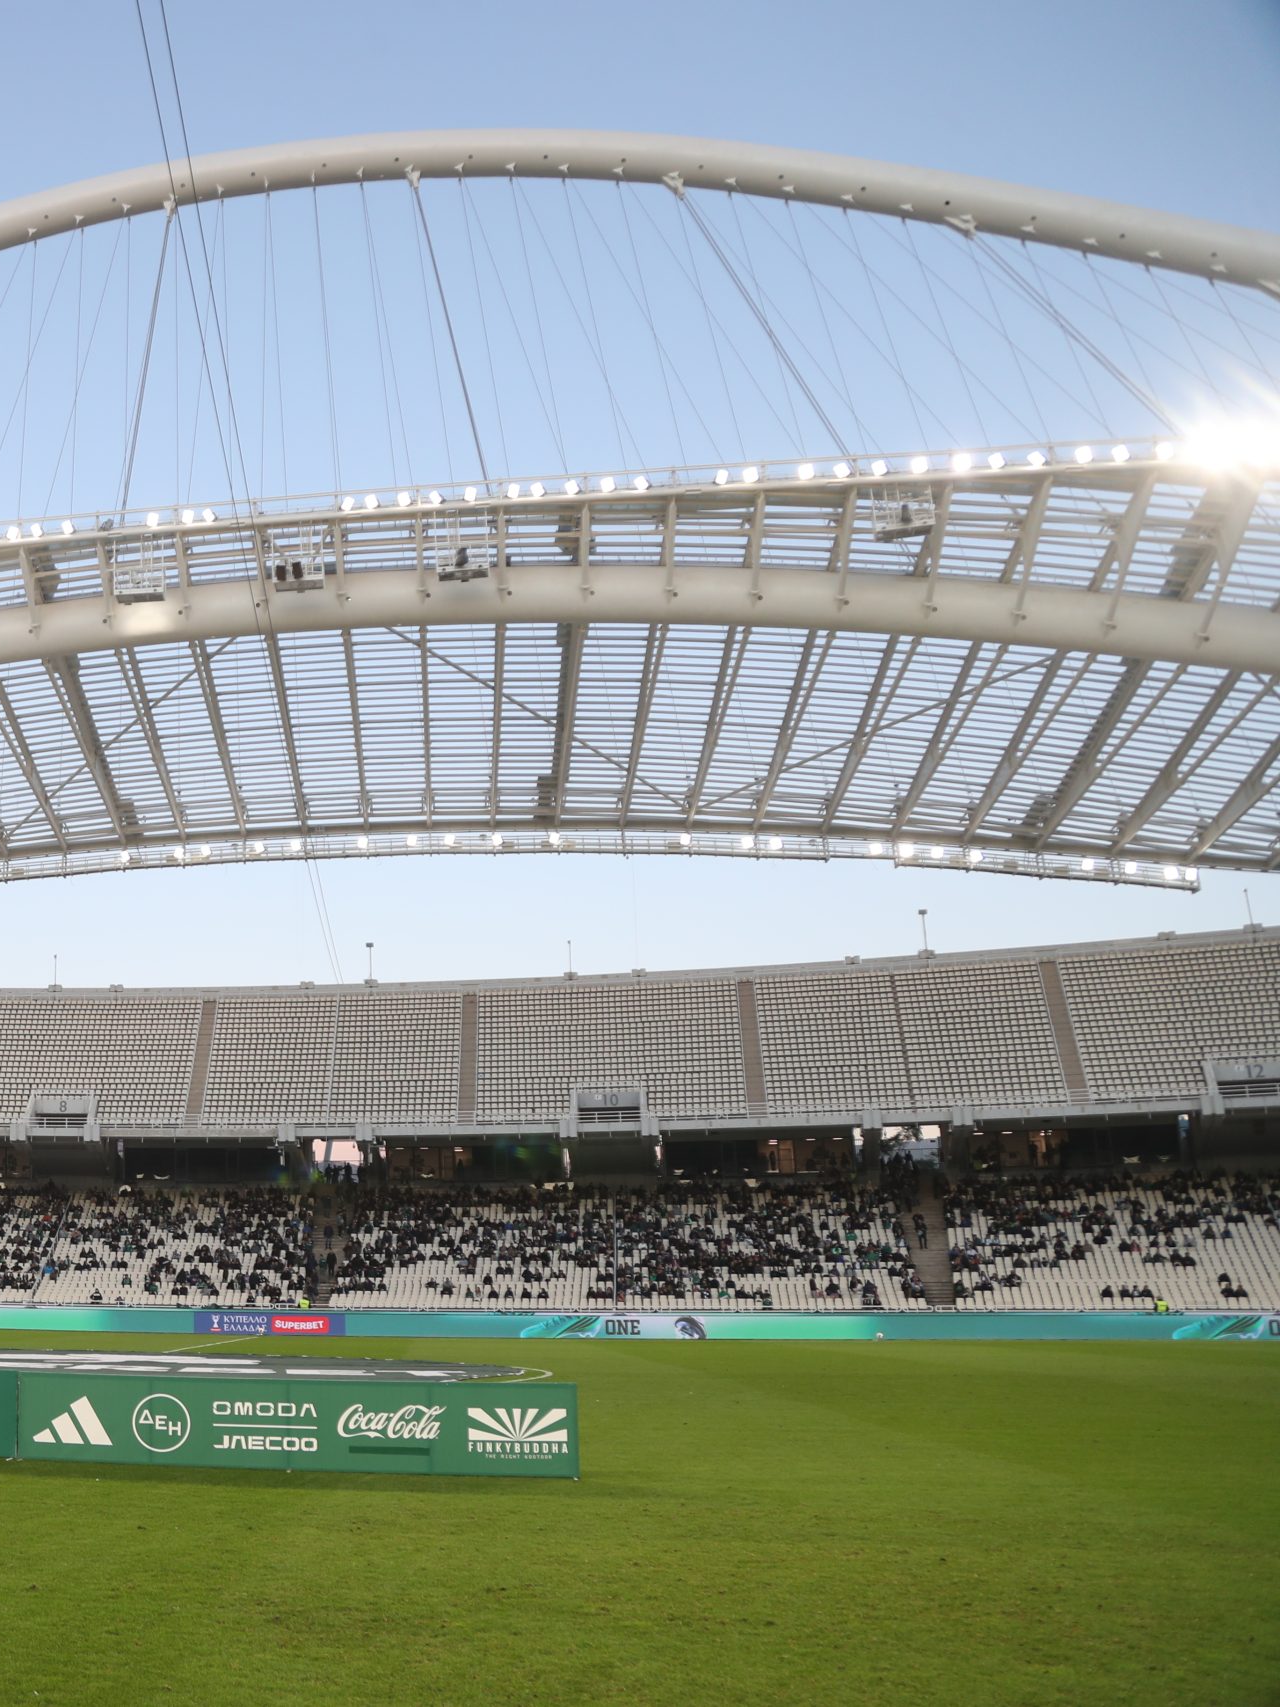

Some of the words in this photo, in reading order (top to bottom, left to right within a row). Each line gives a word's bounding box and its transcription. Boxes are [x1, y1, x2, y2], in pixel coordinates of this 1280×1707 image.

[1245, 1064, 1265, 1078] 12
[59, 1100, 67, 1112] 8
[602, 1094, 619, 1106] 10
[275, 1319, 324, 1330] SUPERBET
[605, 1319, 641, 1336] ONE
[212, 1401, 317, 1418] OMODA
[337, 1403, 447, 1440] Coca-Cola
[213, 1435, 318, 1452] JAECOO
